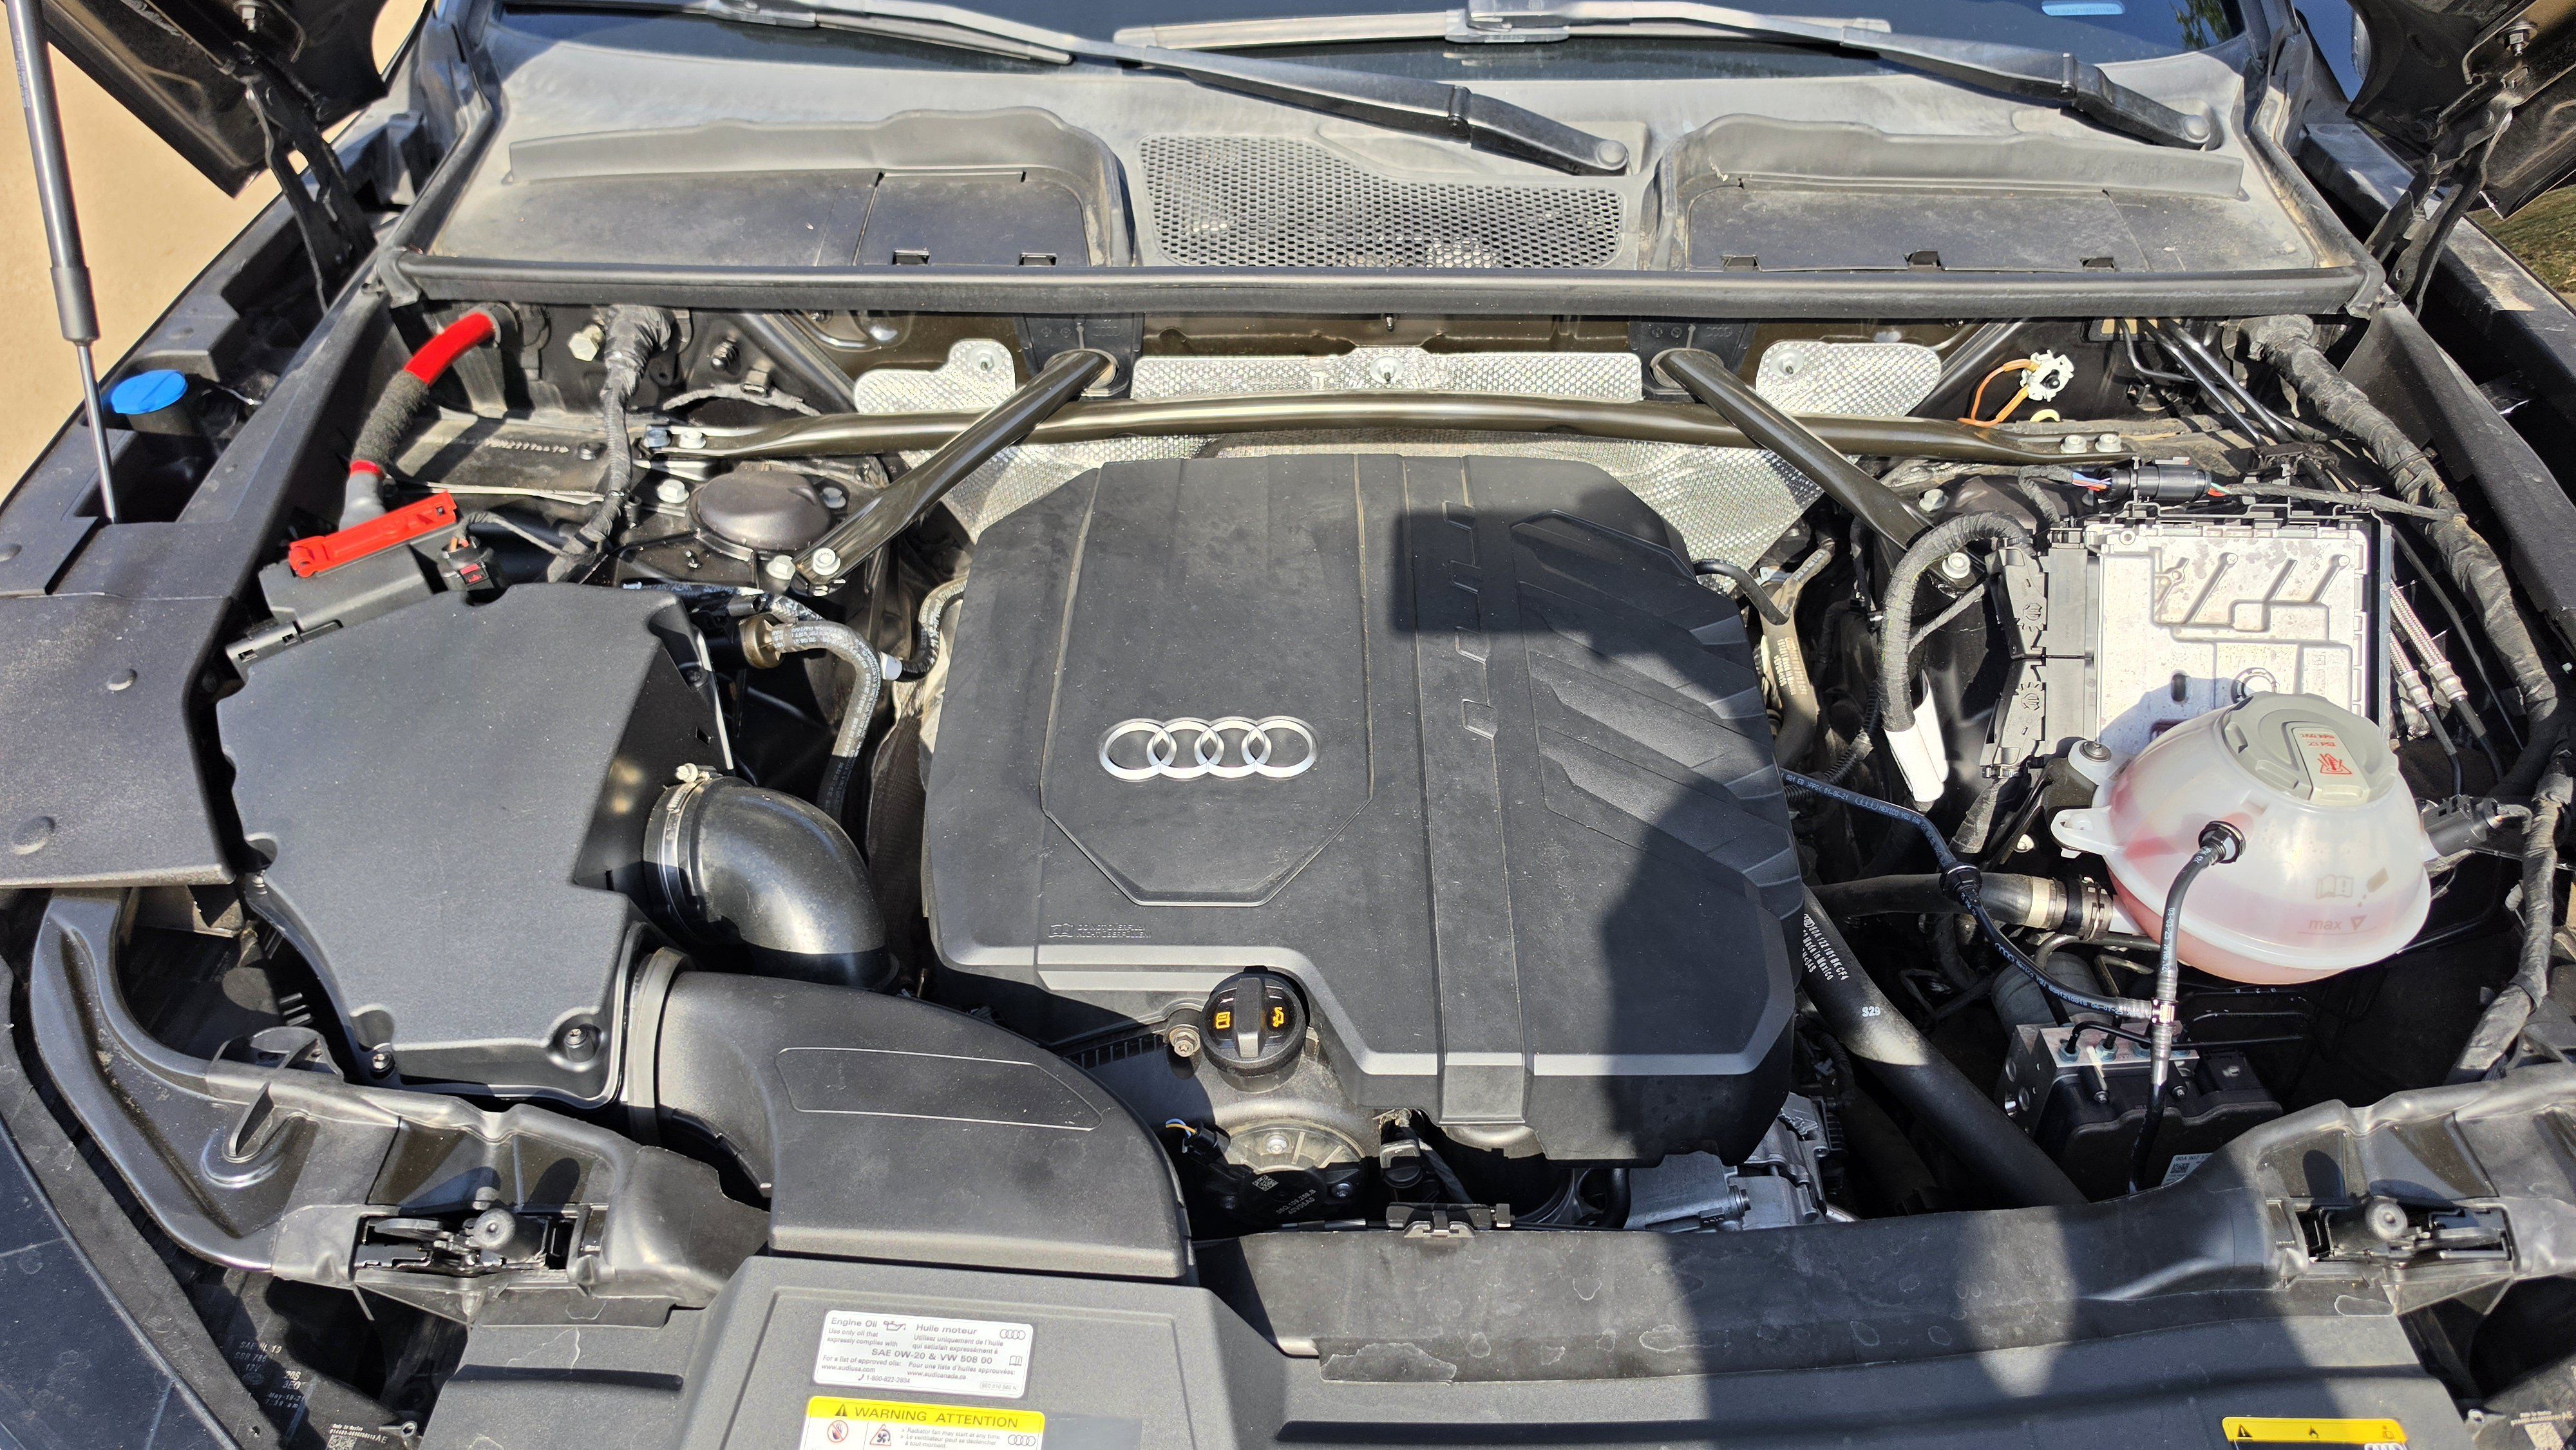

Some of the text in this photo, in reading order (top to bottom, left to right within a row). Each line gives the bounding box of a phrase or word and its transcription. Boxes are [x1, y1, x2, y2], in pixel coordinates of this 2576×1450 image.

[1823, 787, 1850, 800] 01-06-21
[1878, 804, 1900, 817] MEXICO
[2308, 919, 2343, 930] max
[1815, 956, 1836, 981] Mexico
[2016, 959, 2034, 977] Mexico
[831, 1317, 862, 1327] Engine
[916, 1324, 939, 1332] Huile
[937, 1336, 974, 1344] uniquement
[270, 1344, 282, 1353] 19
[872, 1348, 892, 1357] SAE
[894, 1351, 925, 1359] 0W-20
[821, 1364, 876, 1373] www.audiusa.com
[866, 1375, 911, 1383] 1-800-822-2834
[907, 1371, 967, 1380] www.audicanada.ca
[855, 1406, 1018, 1428] WARNING ATTENTION
